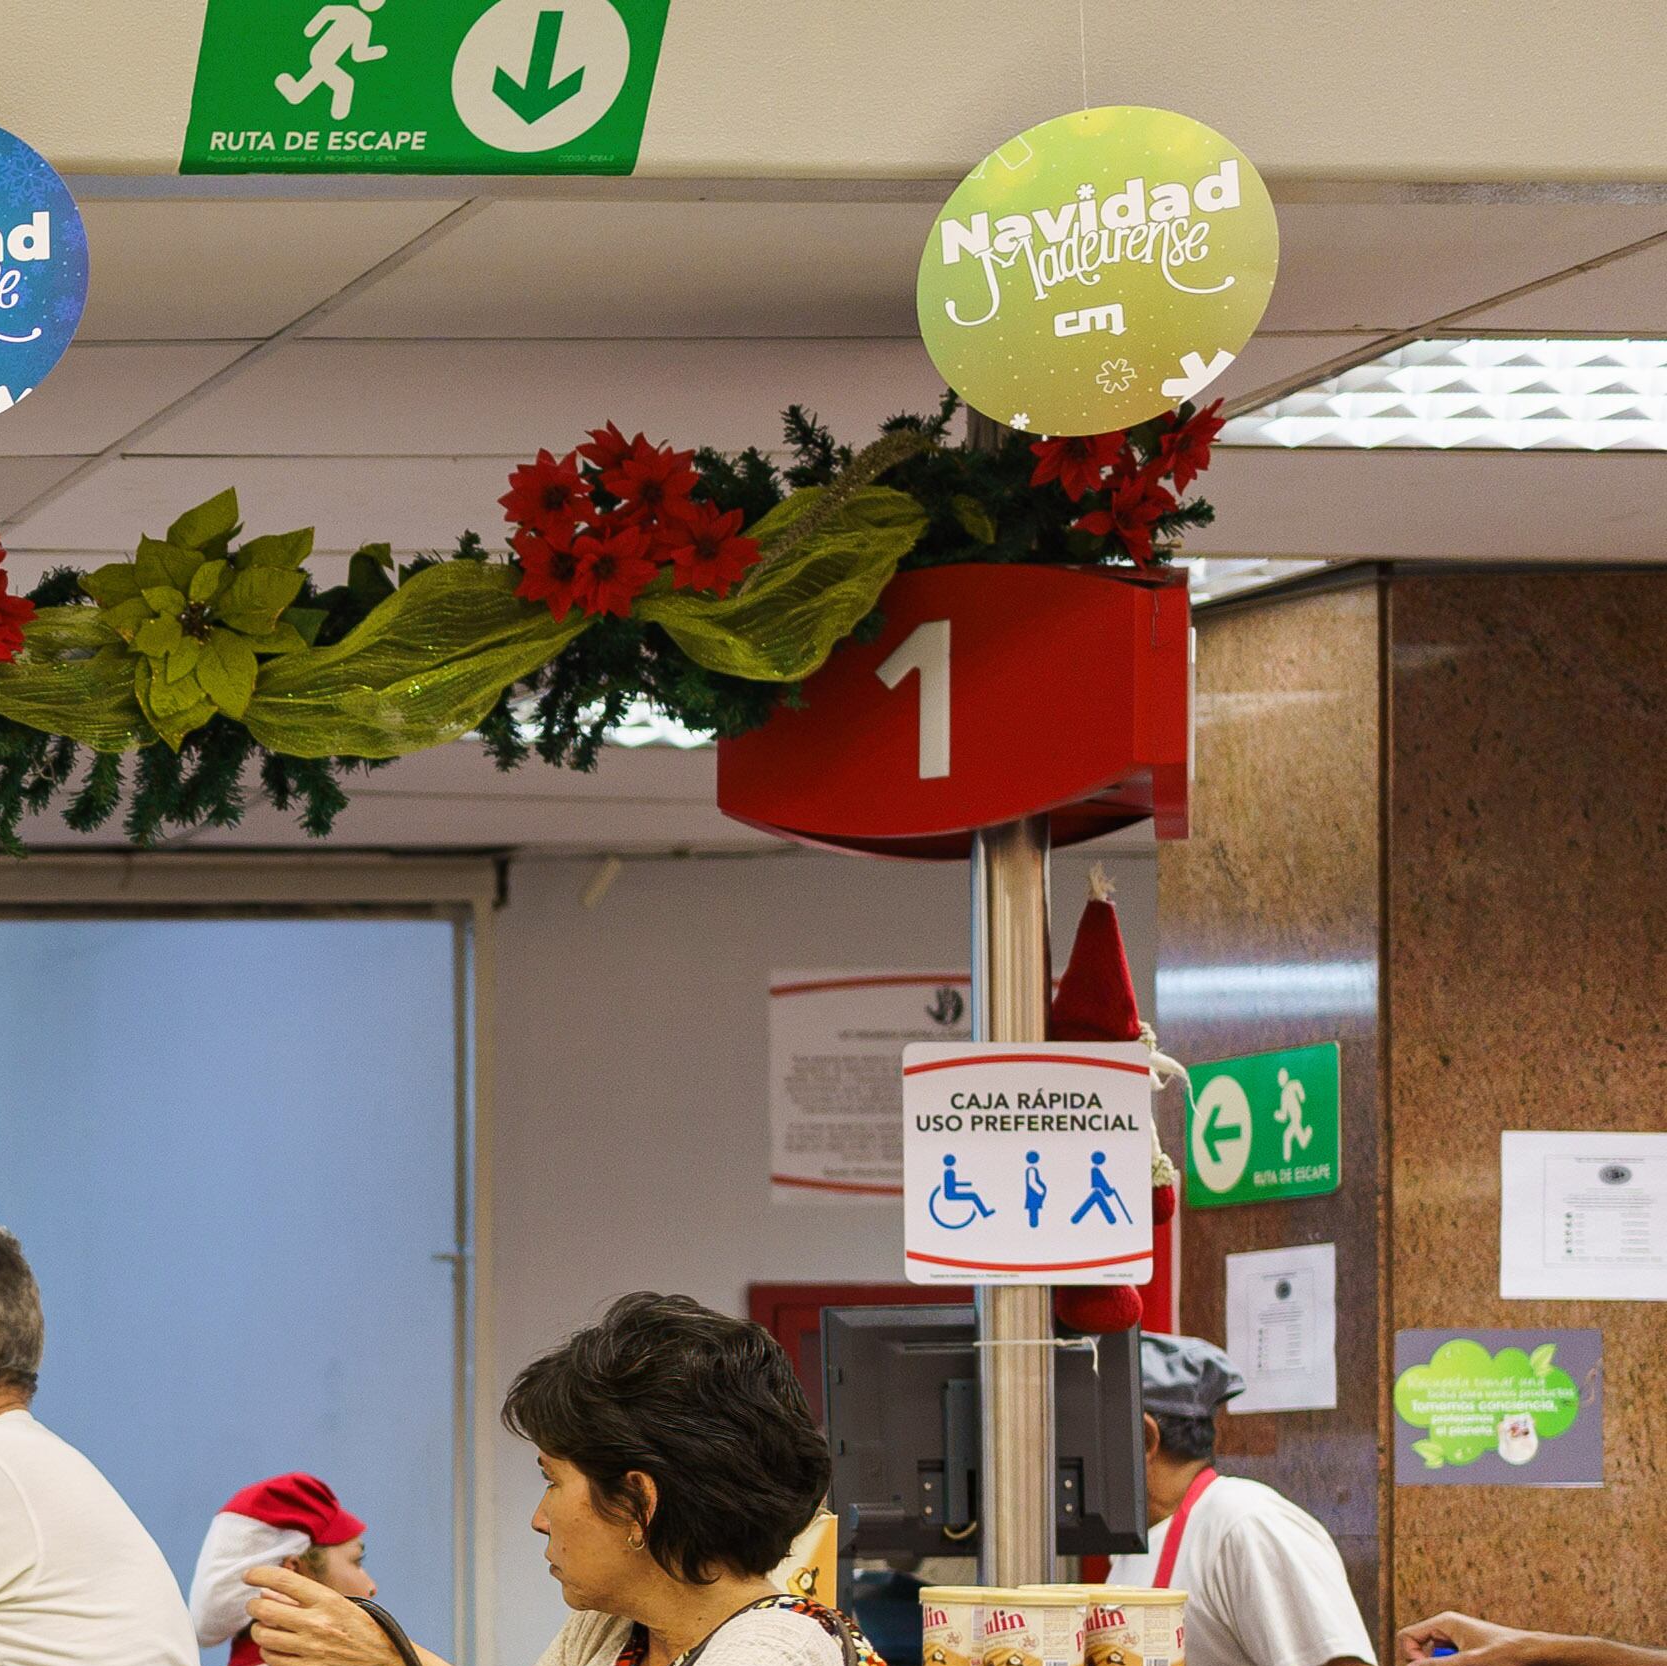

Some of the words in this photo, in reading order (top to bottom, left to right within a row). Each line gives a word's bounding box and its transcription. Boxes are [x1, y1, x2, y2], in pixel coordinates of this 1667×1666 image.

[210, 131, 276, 151] RUTA
[284, 131, 320, 151] DE
[327, 131, 428, 151] ESCAPE
[940, 158, 1241, 265] Navidad
[875, 618, 952, 780] 1
[950, 1093, 1013, 1110] CAJA
[1017, 1088, 1103, 1110] RÁPIDA
[916, 1115, 963, 1132] USO
[971, 1114, 1139, 1132] PREFERENCIAL
